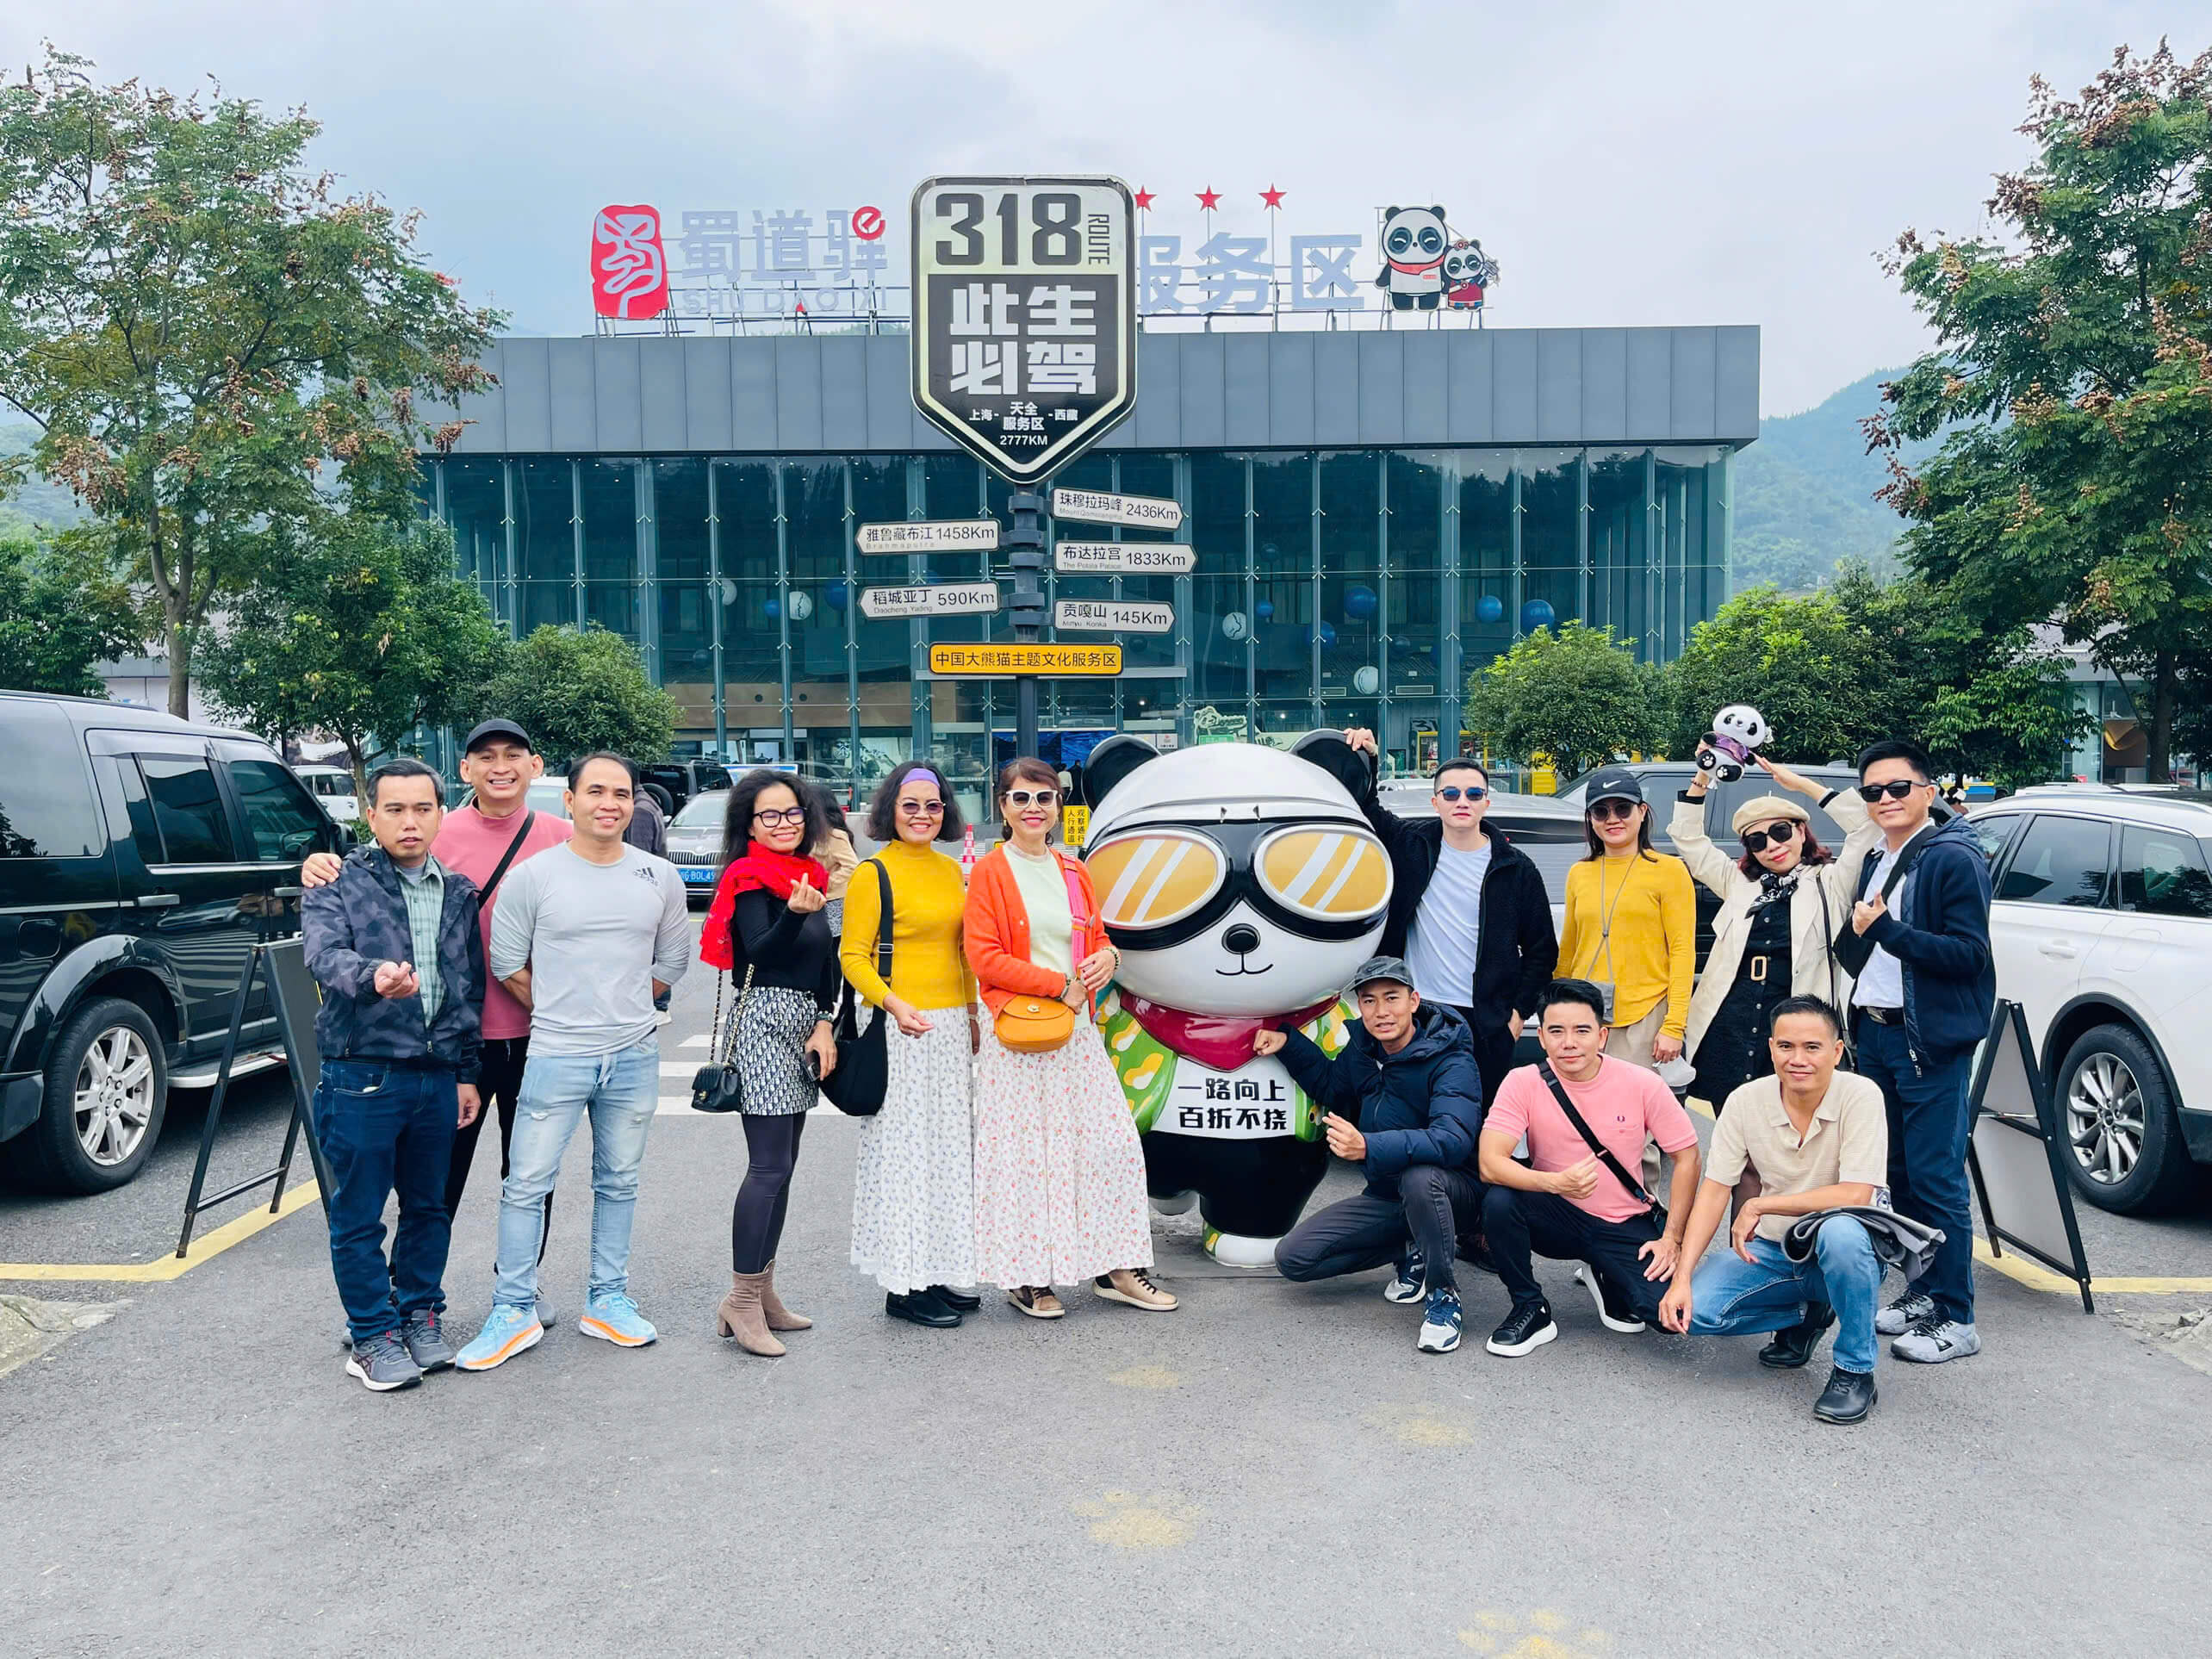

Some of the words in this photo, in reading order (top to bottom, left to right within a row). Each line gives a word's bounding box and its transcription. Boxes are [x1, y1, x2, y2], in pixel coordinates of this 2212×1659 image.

[935, 192, 1082, 266] 318
[1088, 214, 1110, 265] ROUTE
[682, 287, 745, 314] SHU
[763, 288, 841, 313] DAO
[949, 283, 1097, 336] 此生
[949, 340, 1097, 395] 必驾
[1009, 401, 1039, 416] 天全
[1002, 416, 1046, 432] 服务区
[998, 434, 1048, 446] 2777KM
[1126, 503, 1178, 521] 2436Km
[866, 526, 933, 543] 雅鲁藏布江
[935, 525, 995, 540] 1458Km
[1063, 544, 1122, 561] 布达拉宫
[1125, 552, 1186, 566] 1833Km
[873, 589, 932, 606] 稻城亚丁
[937, 591, 995, 606] 590Km
[1063, 603, 1107, 618] 贡嘎山
[1112, 610, 1168, 625] 145Km
[935, 650, 1118, 668] 中国大熊猫主题文化服务区
[1177, 1078, 1286, 1102] 一路向上
[1177, 1105, 1287, 1130] 百折不挠
